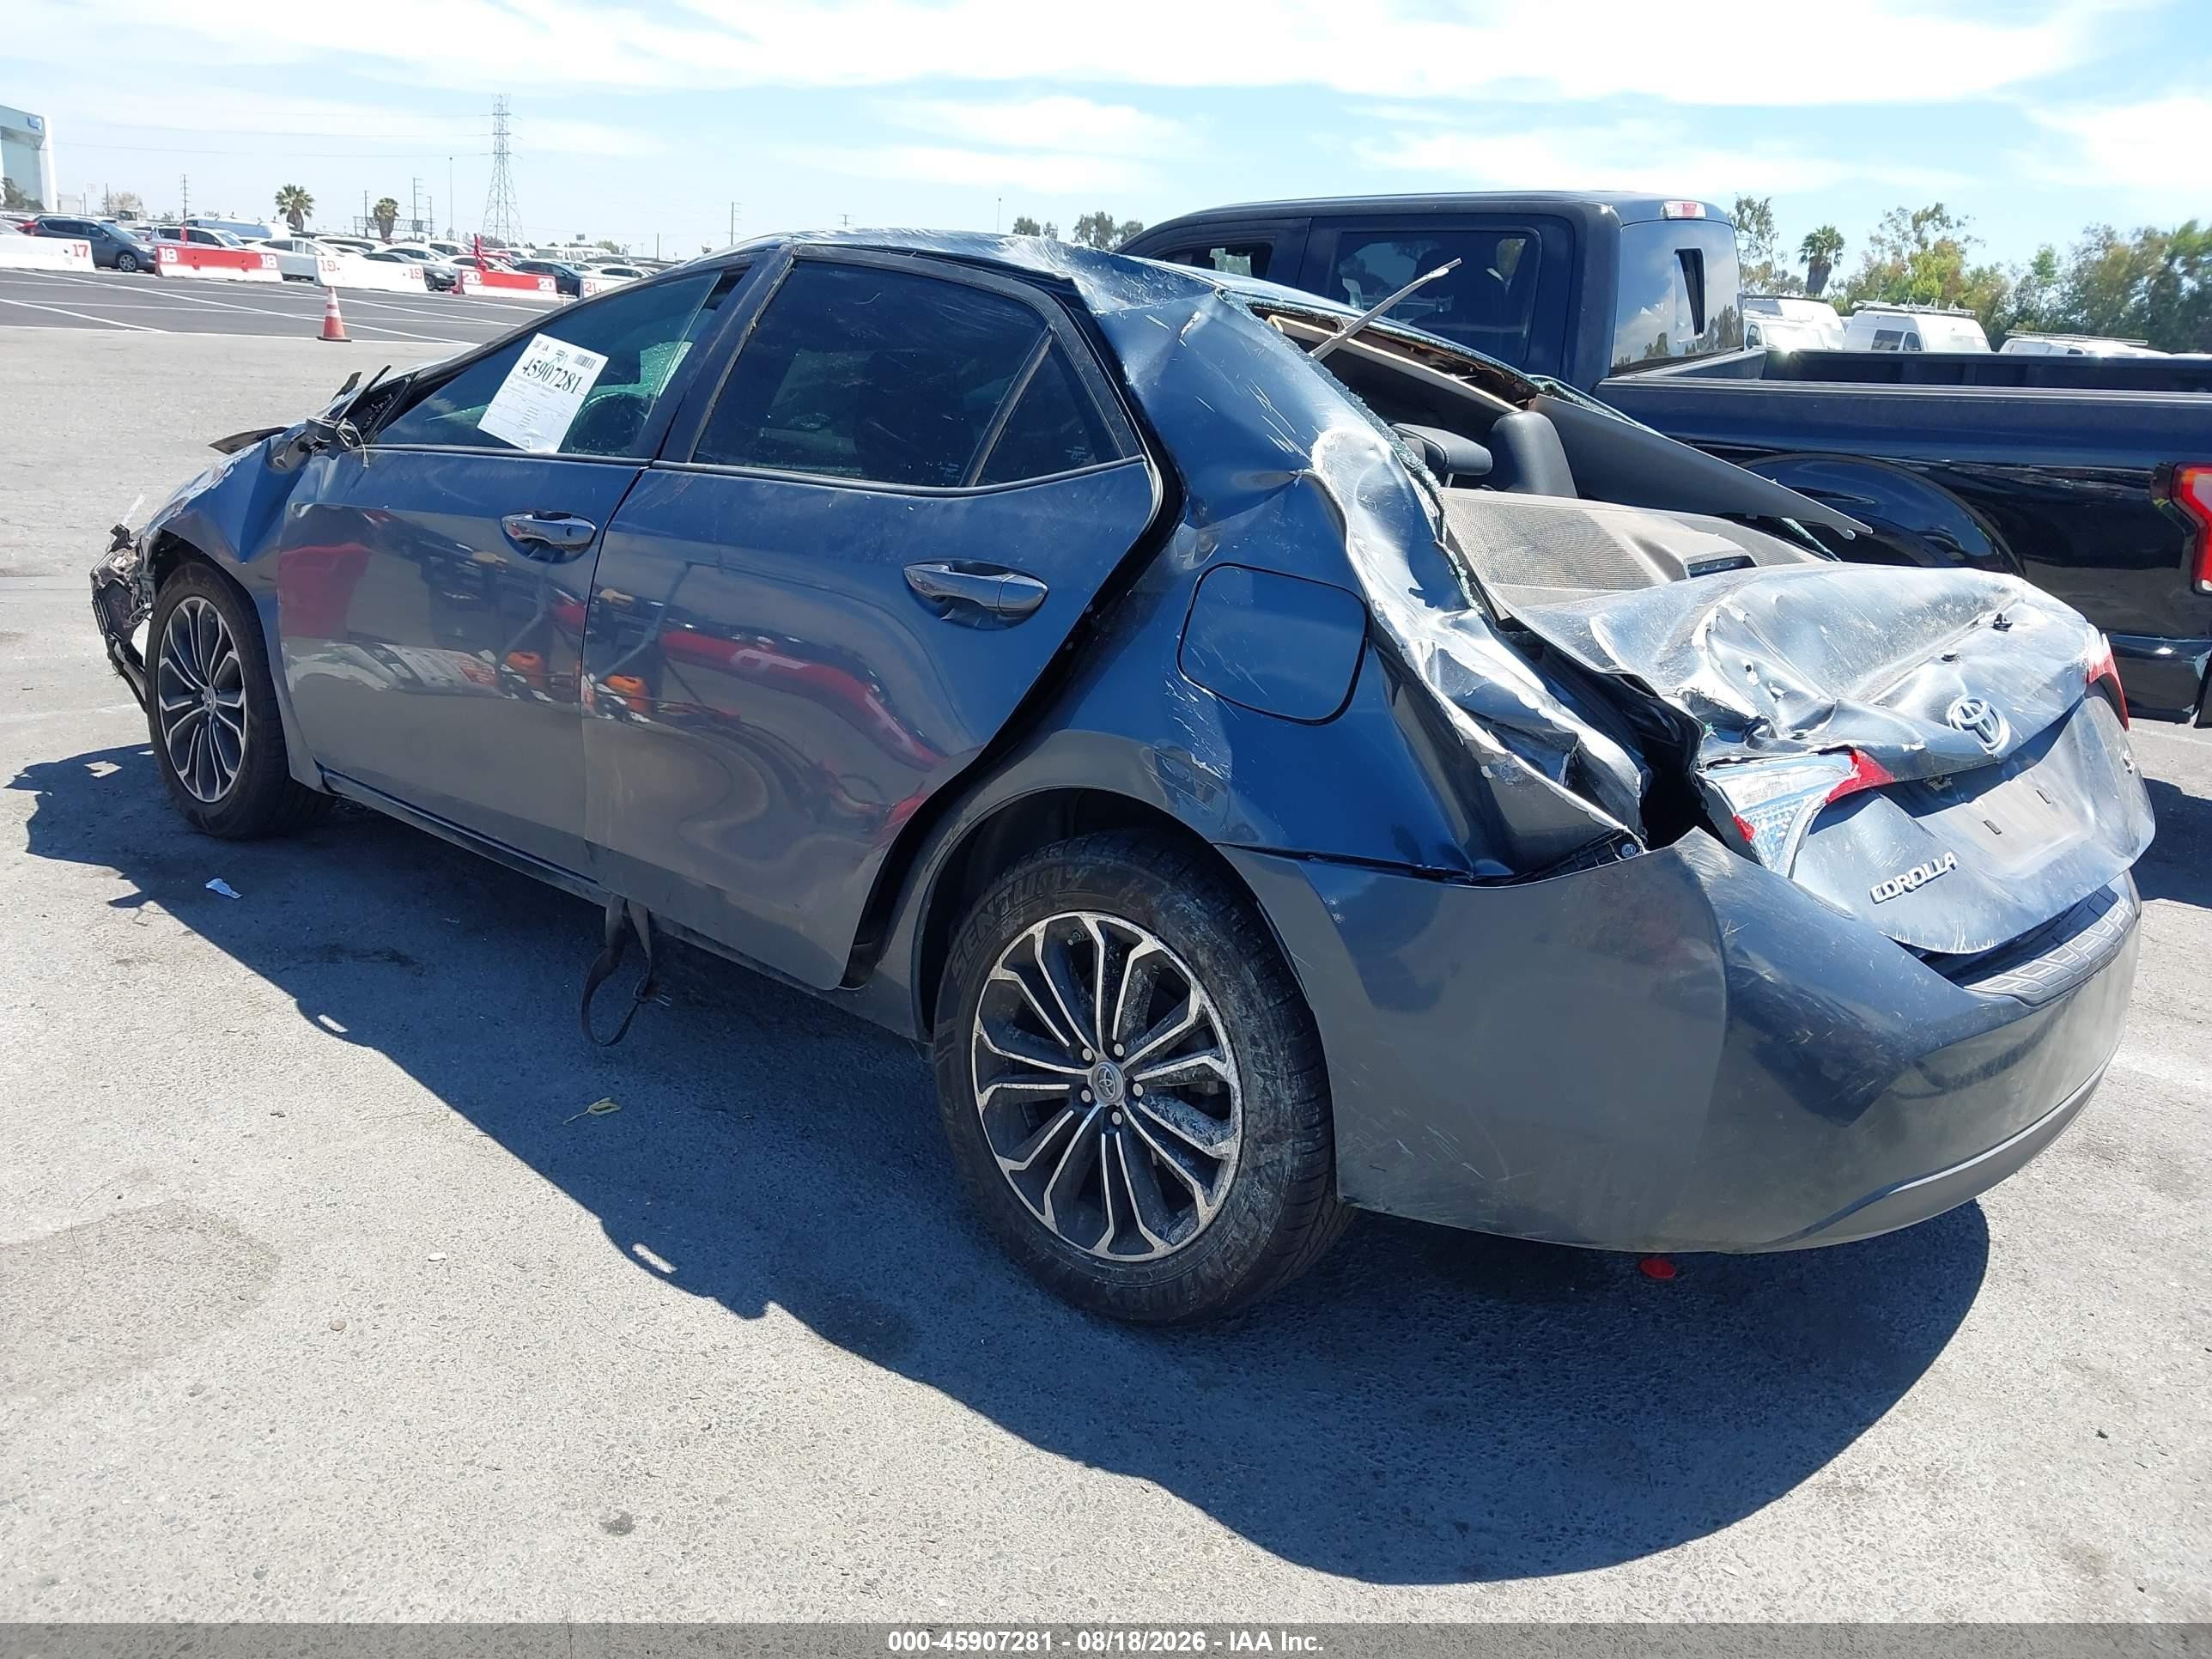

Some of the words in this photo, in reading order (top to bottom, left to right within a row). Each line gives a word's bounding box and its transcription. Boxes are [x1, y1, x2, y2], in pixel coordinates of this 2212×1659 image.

[72, 243, 89, 258] 17
[160, 247, 179, 263] 18
[260, 253, 278, 269] 18
[320, 259, 337, 272] 19
[410, 268, 423, 280] 19
[584, 281, 598, 293] 21
[522, 358, 583, 394] 45907281
[1869, 851, 1958, 904] COROLLA
